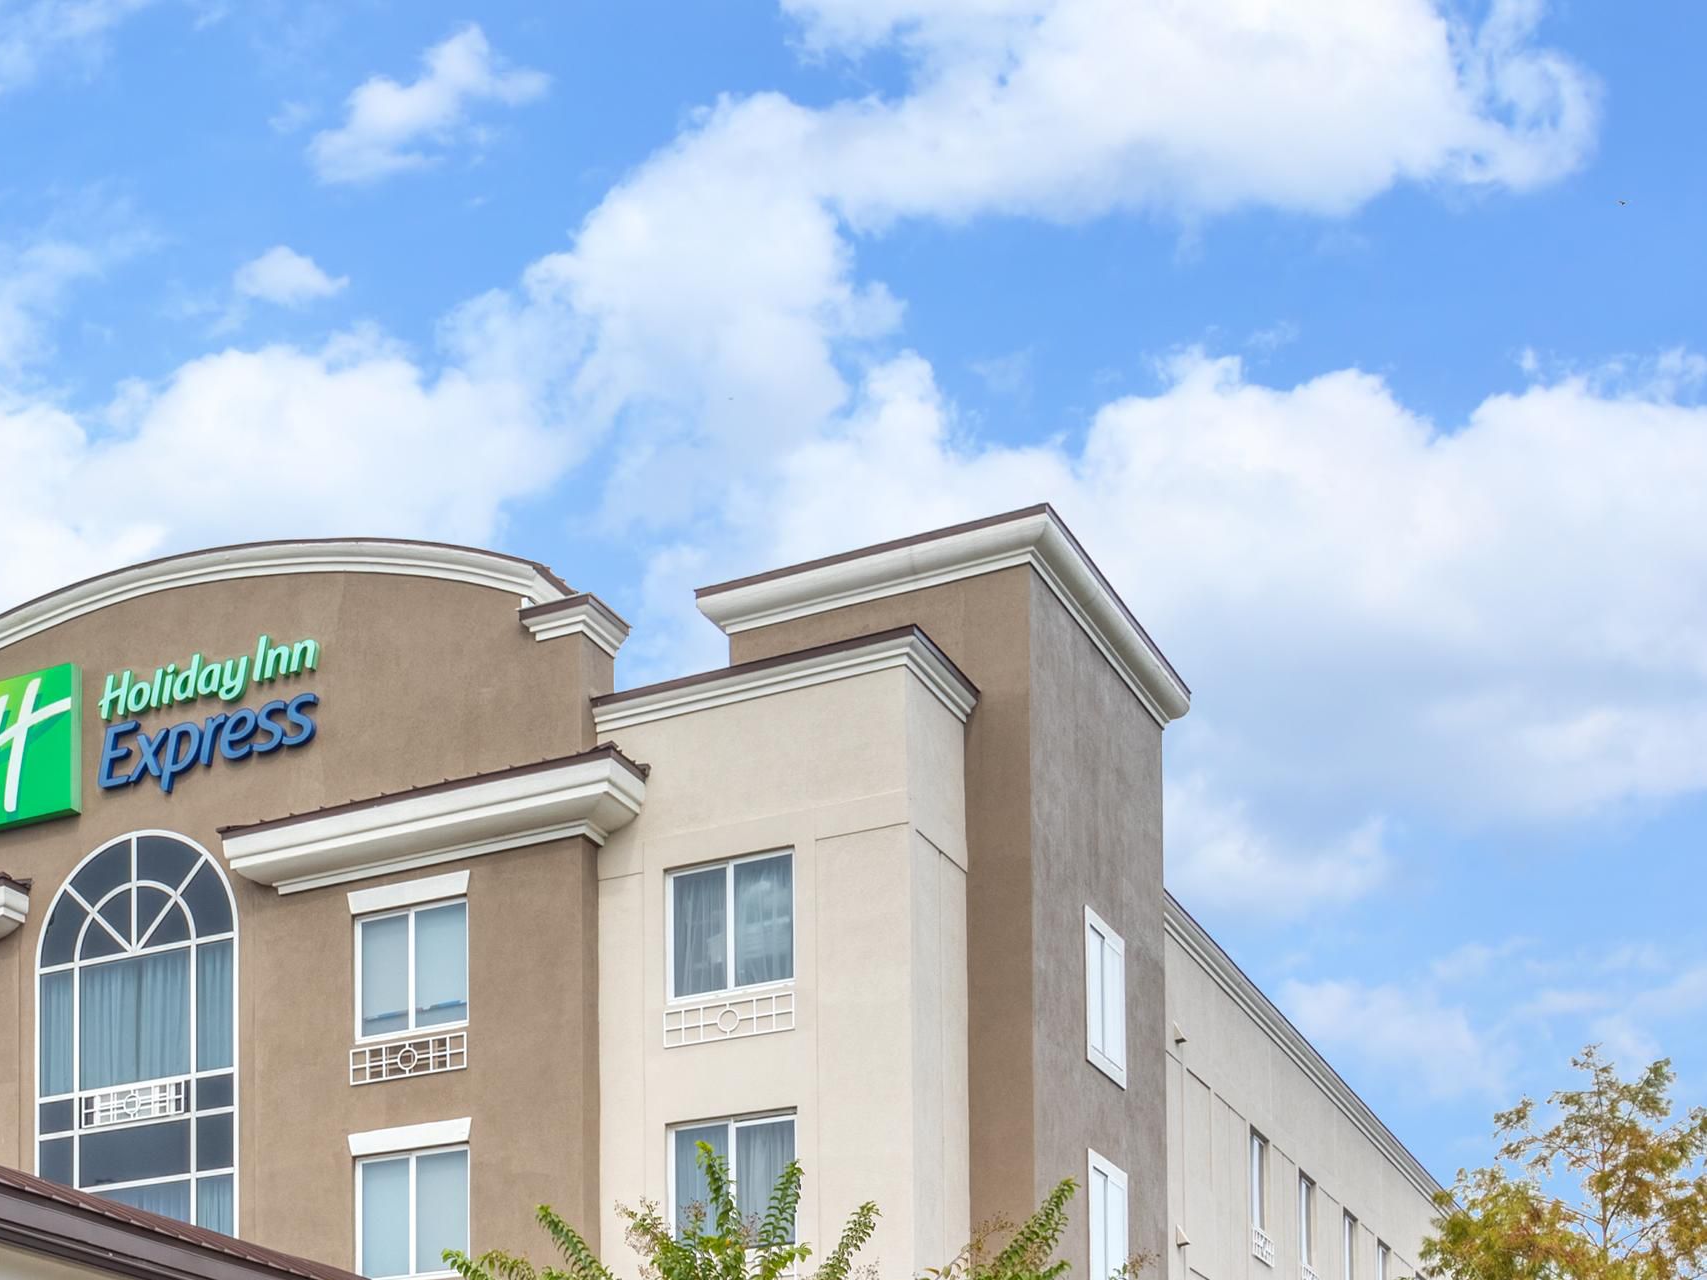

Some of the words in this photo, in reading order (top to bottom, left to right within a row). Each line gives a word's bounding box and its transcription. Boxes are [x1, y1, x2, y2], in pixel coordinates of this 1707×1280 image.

[98, 652, 250, 721] Holiday
[252, 634, 320, 684] Inn
[98, 692, 320, 794] Express
